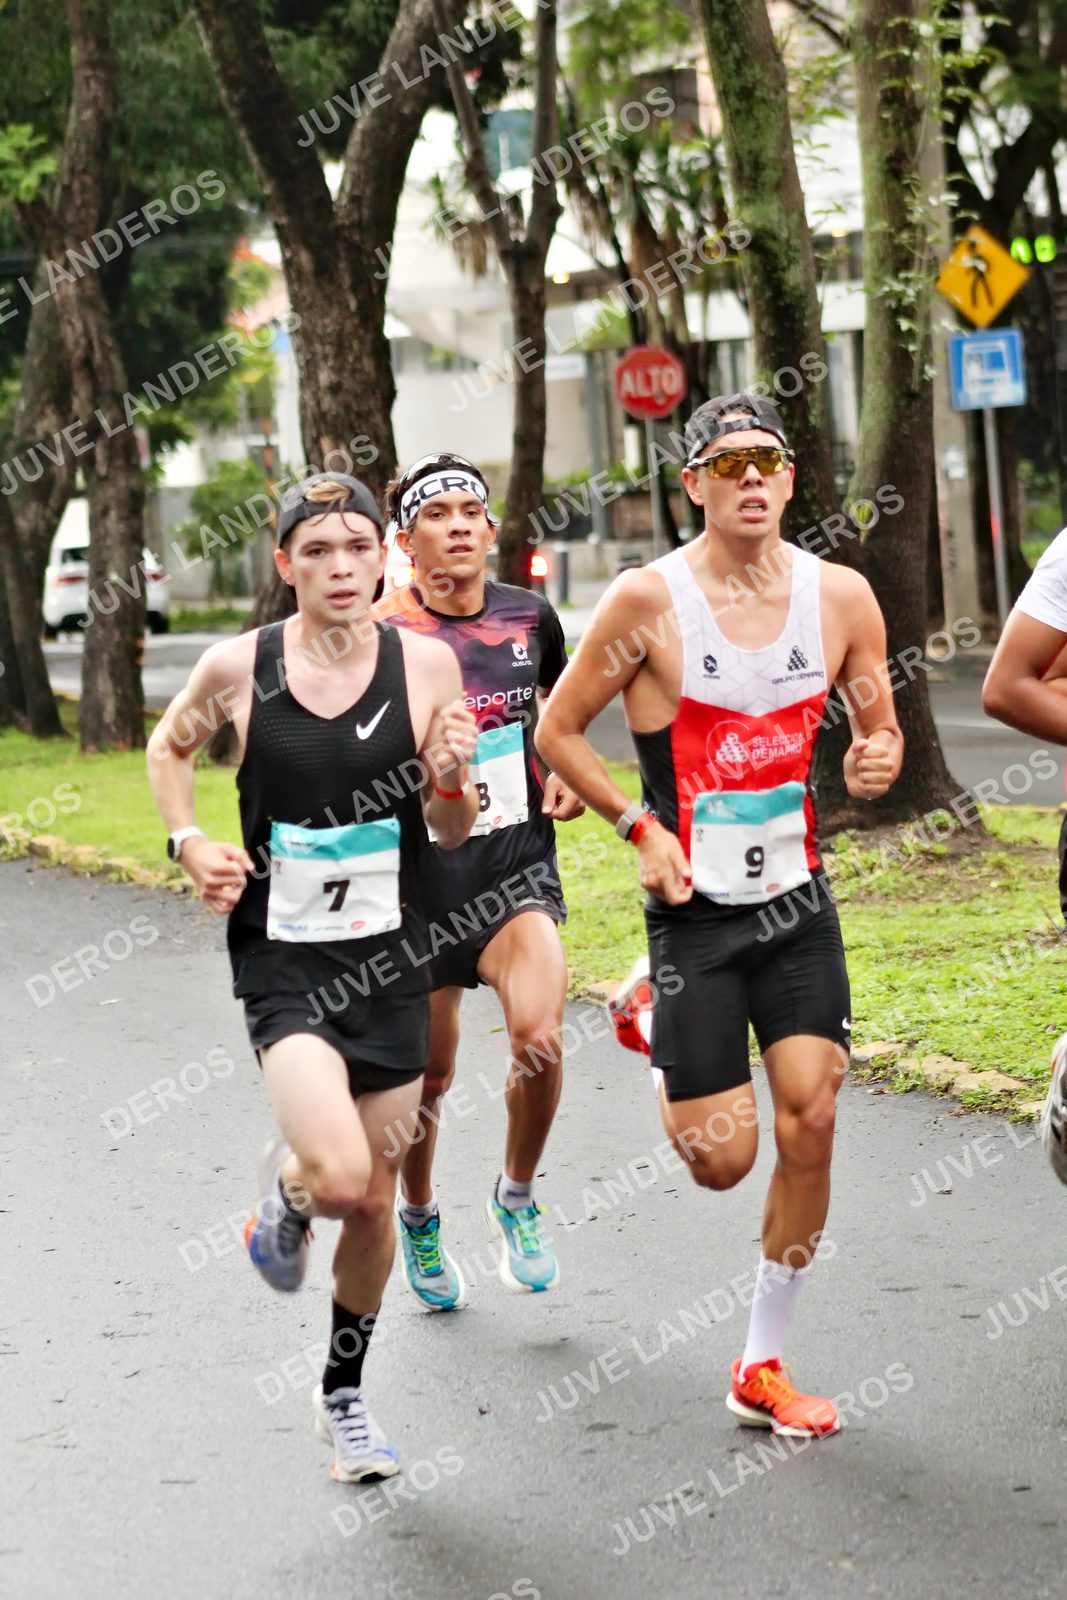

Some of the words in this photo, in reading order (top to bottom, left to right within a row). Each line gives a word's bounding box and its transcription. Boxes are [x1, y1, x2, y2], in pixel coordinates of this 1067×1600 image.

[621, 368, 677, 397] ALTO
[464, 687, 533, 711] eporte
[745, 846, 764, 878] 9
[323, 880, 350, 912] 7
